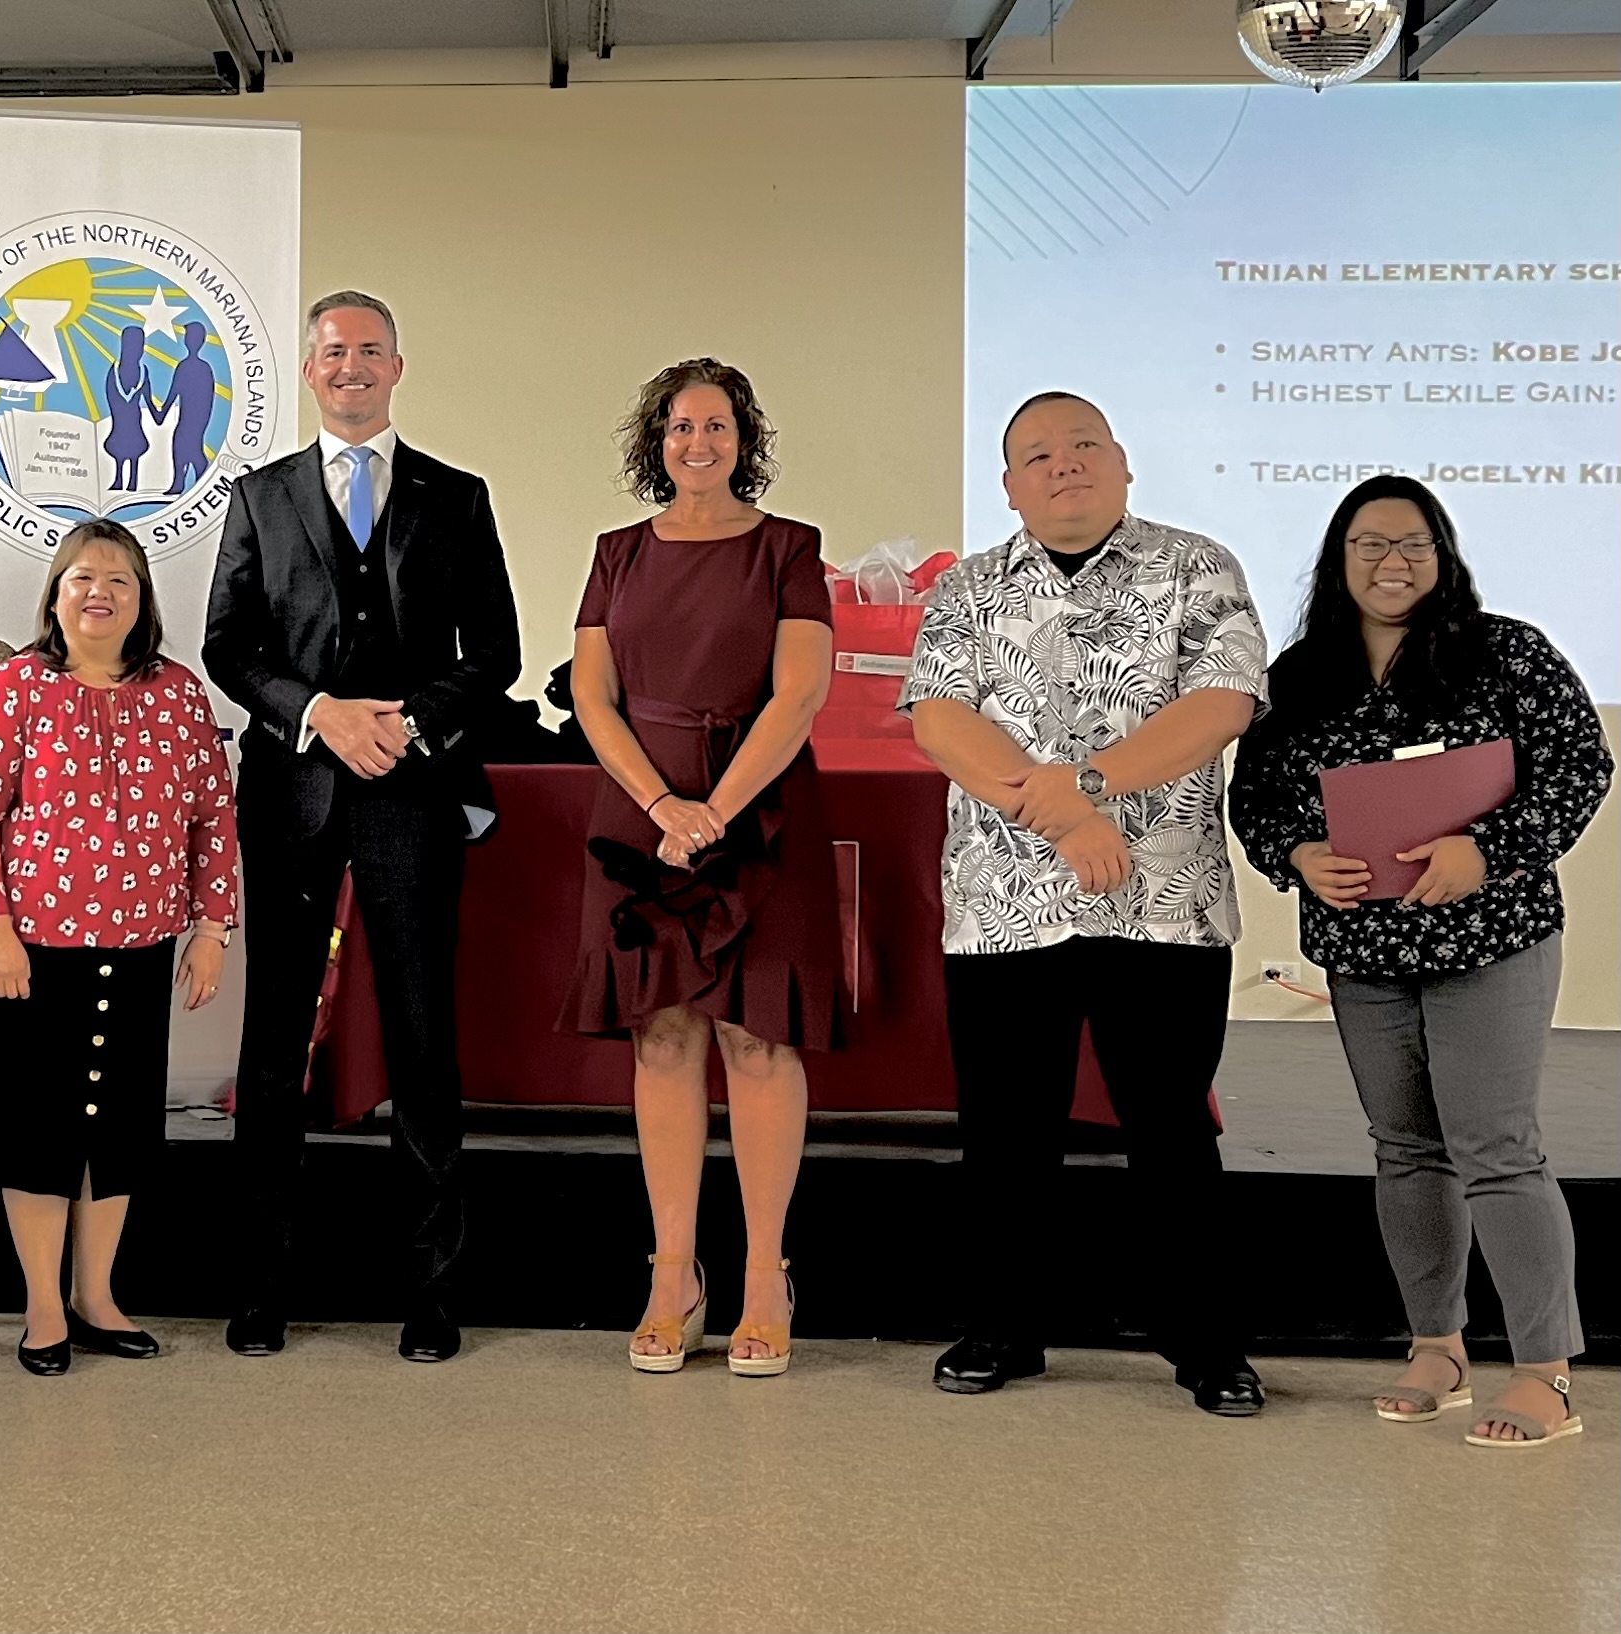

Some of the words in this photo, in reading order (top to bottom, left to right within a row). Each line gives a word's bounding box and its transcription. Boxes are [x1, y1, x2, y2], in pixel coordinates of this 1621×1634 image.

[1215, 260, 1327, 281] TINIAN
[1341, 263, 1557, 281] ELEMENTARY
[2, 240, 28, 266] OF
[32, 226, 76, 251] THE
[83, 224, 198, 273] NORTHERN
[195, 267, 257, 356] MARIANA
[241, 359, 265, 447] ISLANDS
[1252, 341, 1374, 362] SMARTY
[1386, 341, 1478, 362] ANTS:
[1492, 341, 1579, 362] KOBE
[1253, 381, 1392, 402] HIGHEST
[1404, 381, 1515, 402] LEXILE
[1527, 381, 1615, 402] GAIN:
[40, 427, 80, 440] Founded
[1419, 462, 1565, 483] JOCELYN
[1580, 463, 1621, 483] KI
[153, 475, 232, 544] SYSTEM
